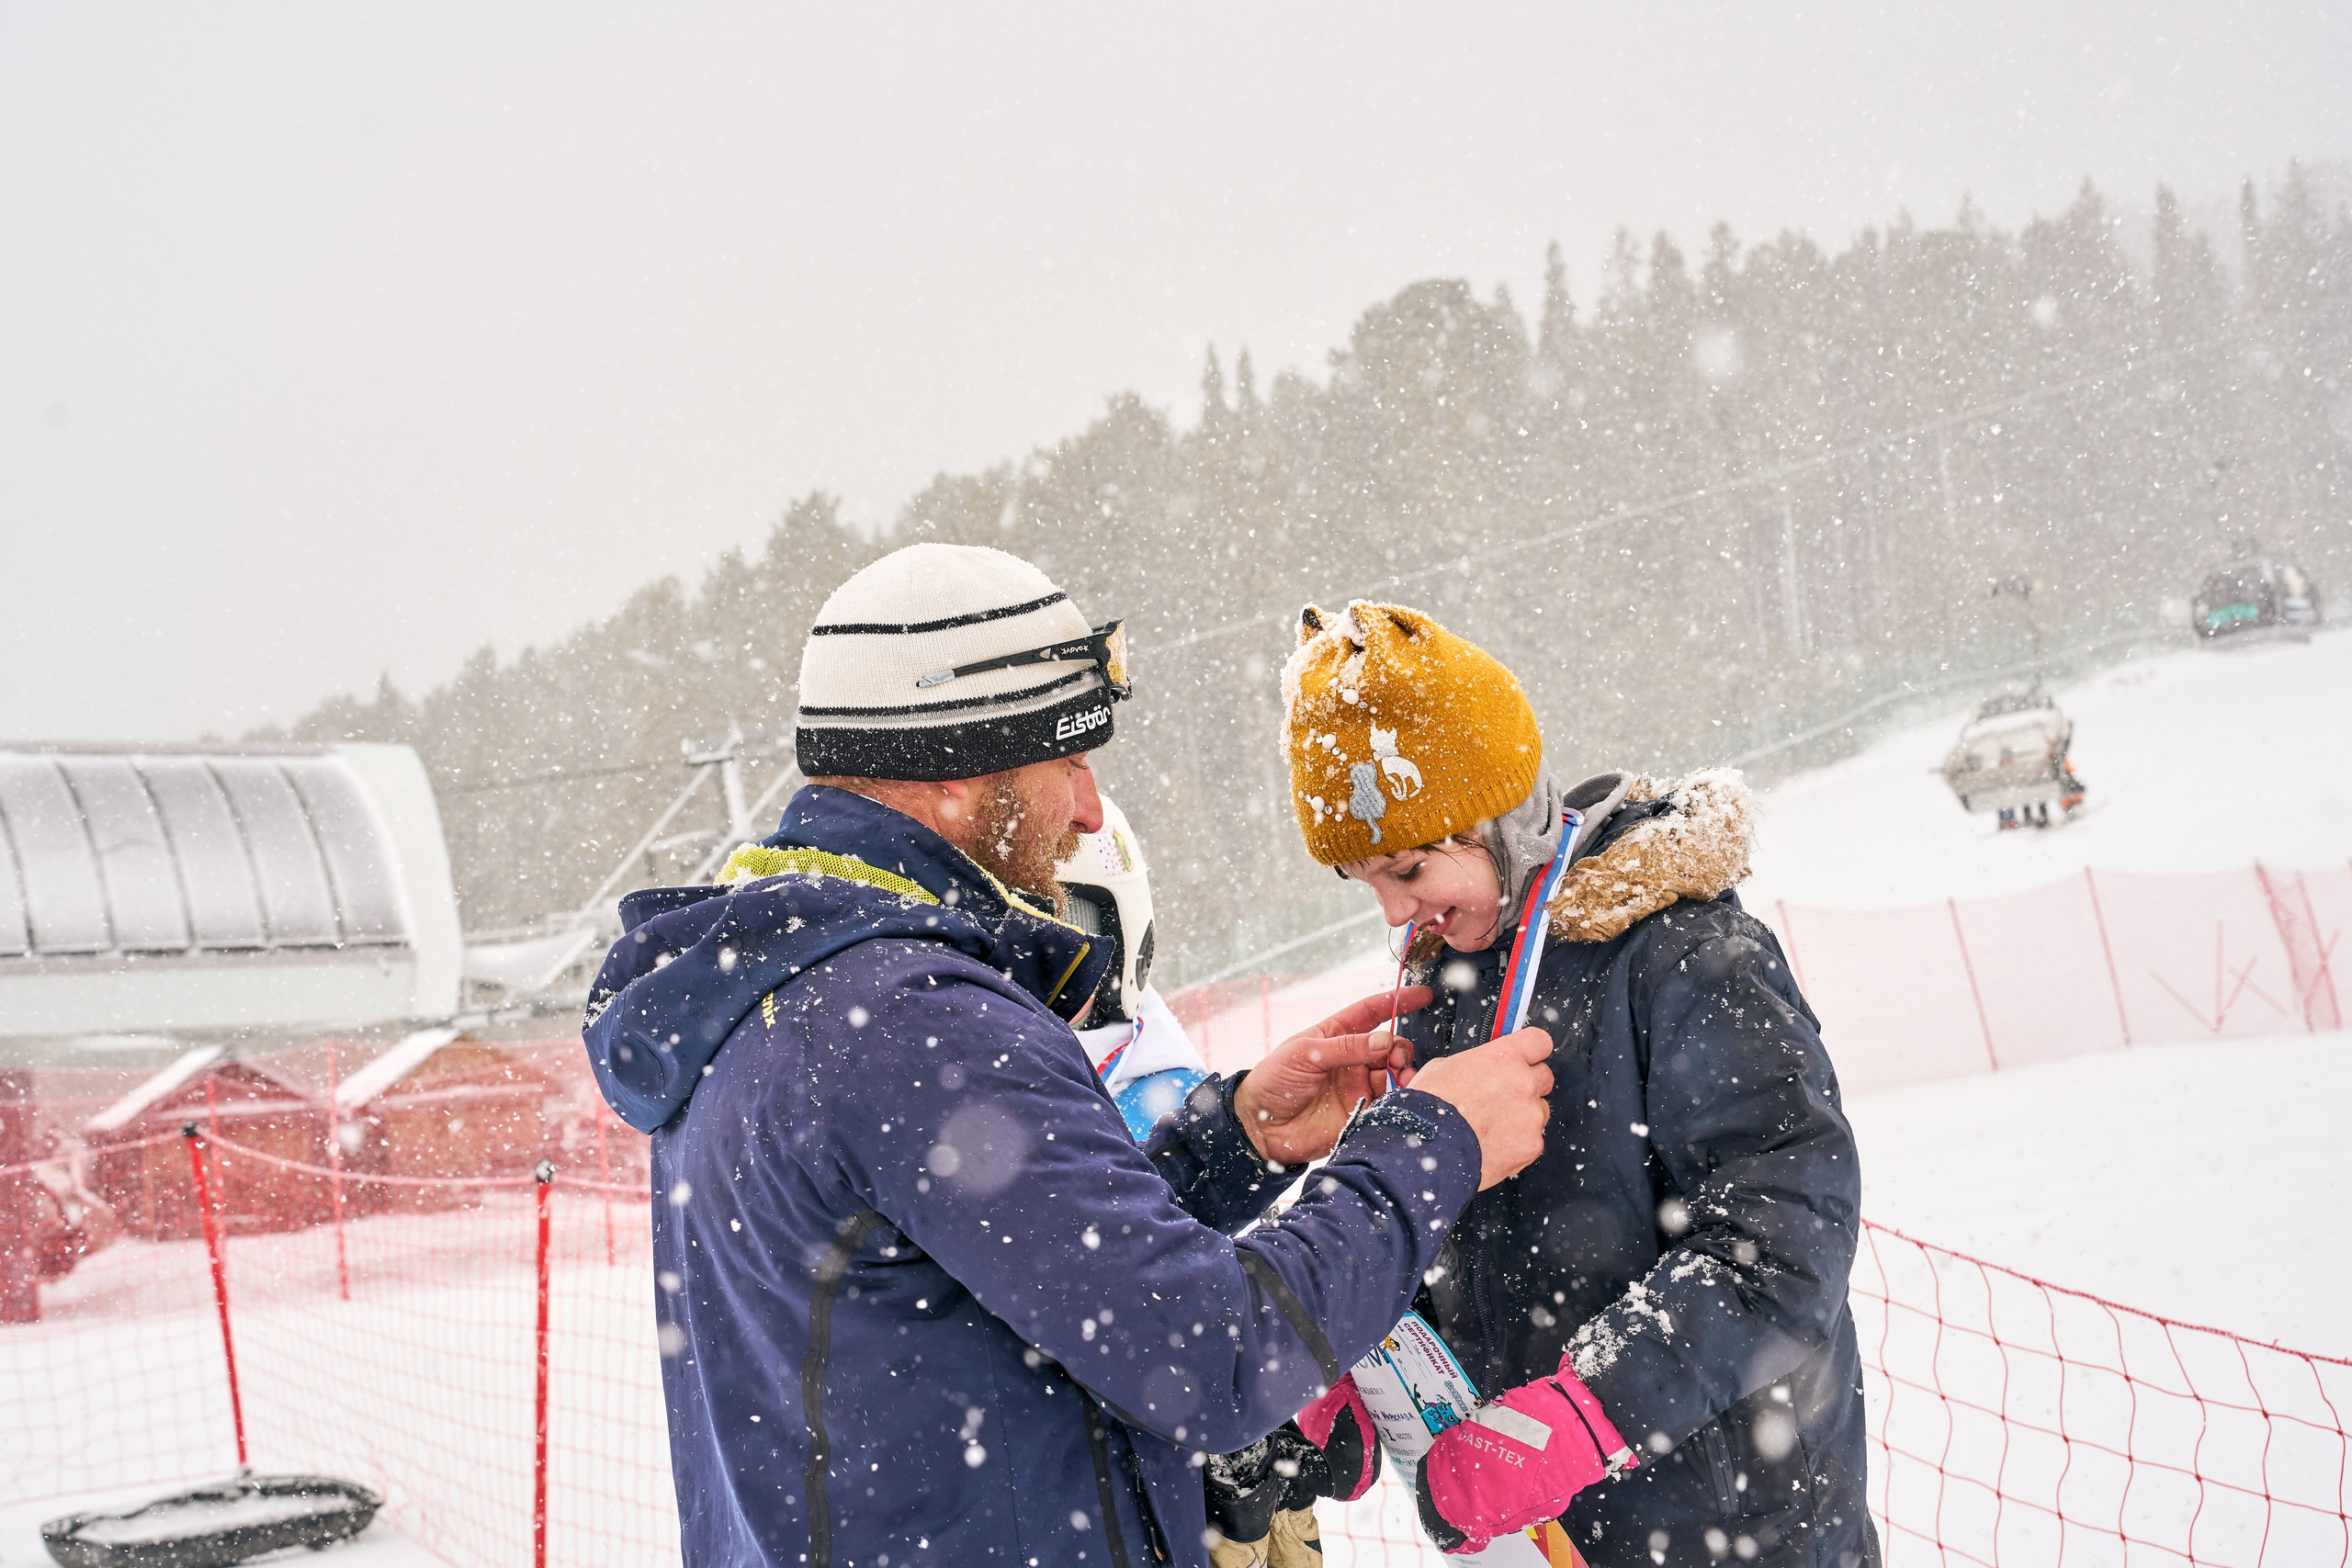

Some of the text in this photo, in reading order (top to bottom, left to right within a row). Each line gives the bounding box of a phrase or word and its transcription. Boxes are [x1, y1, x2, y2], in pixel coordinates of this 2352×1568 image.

[1056, 704, 1111, 740] Eisbär
[1404, 1323, 1444, 1375] СЕРТИФИКАТ
[1411, 1321, 1458, 1379] ПОДАРОЧНЫЙ
[1458, 1429, 1526, 1469] CAST-TEX
